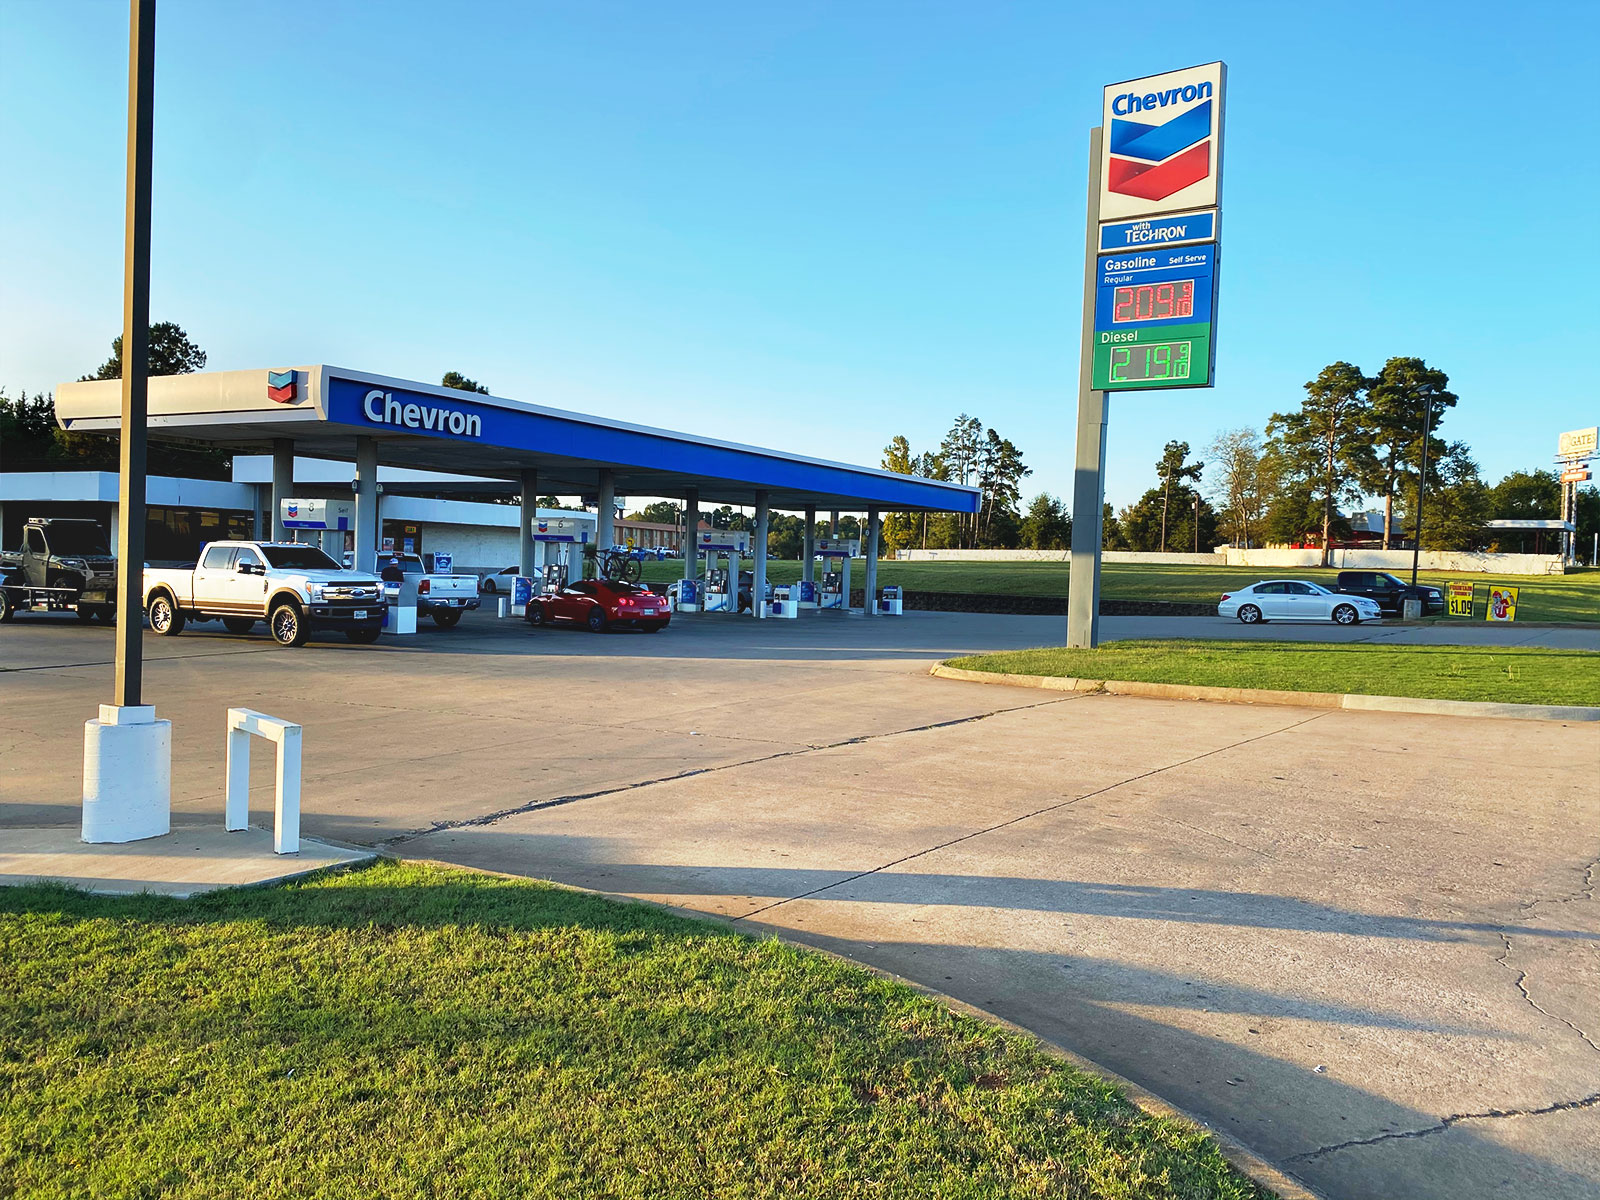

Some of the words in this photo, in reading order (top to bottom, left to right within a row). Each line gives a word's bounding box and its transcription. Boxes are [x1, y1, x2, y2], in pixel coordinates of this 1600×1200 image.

[1112, 81, 1213, 116] Chevron
[1132, 221, 1151, 231] with
[1125, 226, 1187, 244] TECHRON
[1105, 256, 1157, 272] Gasoline
[1169, 256, 1184, 265] Self
[1185, 254, 1207, 263] Serve
[1104, 275, 1134, 285] Regular
[1115, 283, 1175, 321] 209
[1101, 331, 1139, 344] Diesel
[1113, 345, 1172, 381] 219
[363, 389, 482, 437] Chevron
[308, 502, 315, 512] 8
[558, 520, 564, 528] 6
[1451, 599, 1472, 615] $1.09
